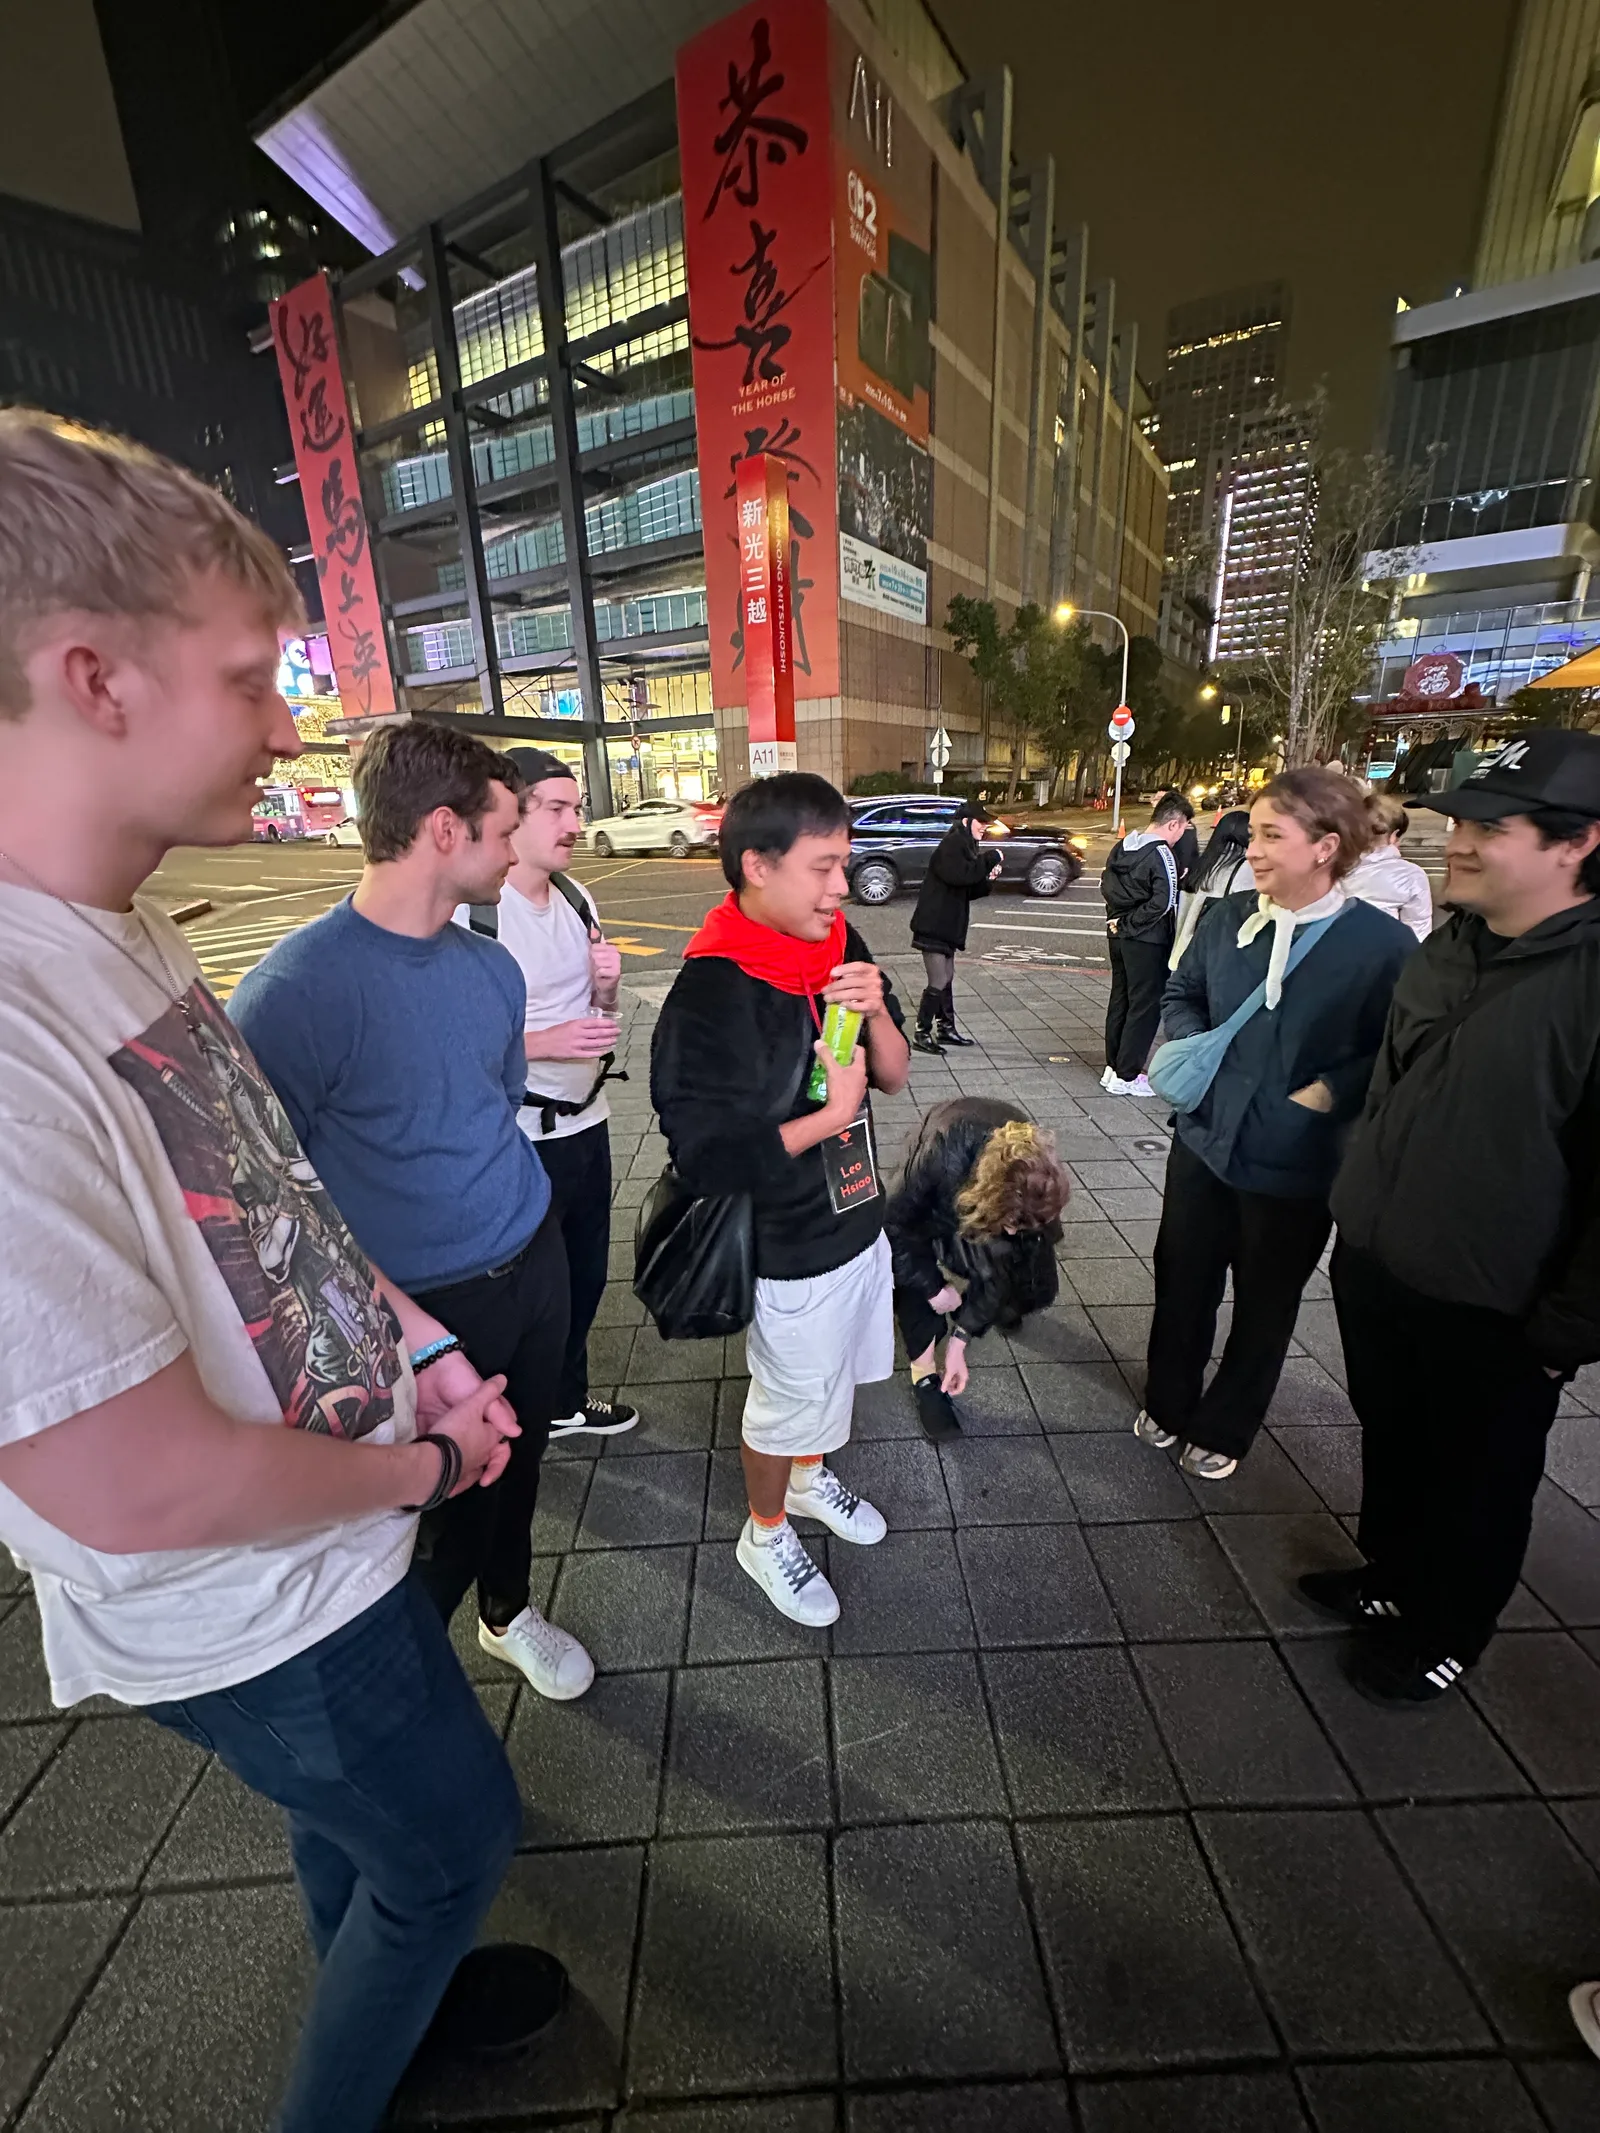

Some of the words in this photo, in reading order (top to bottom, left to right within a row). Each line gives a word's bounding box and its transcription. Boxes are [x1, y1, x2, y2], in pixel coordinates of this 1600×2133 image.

[738, 379, 768, 398] YEAR
[771, 371, 787, 387] OF
[731, 400, 753, 416] THE
[756, 387, 796, 410] HORSE
[742, 497, 767, 625] 新光三越
[776, 539, 784, 582] KONG
[777, 584, 787, 674] MITSUKOSHI
[752, 748, 774, 765] A11
[840, 1162, 862, 1178] Leo
[840, 1175, 871, 1198] Hsiao
